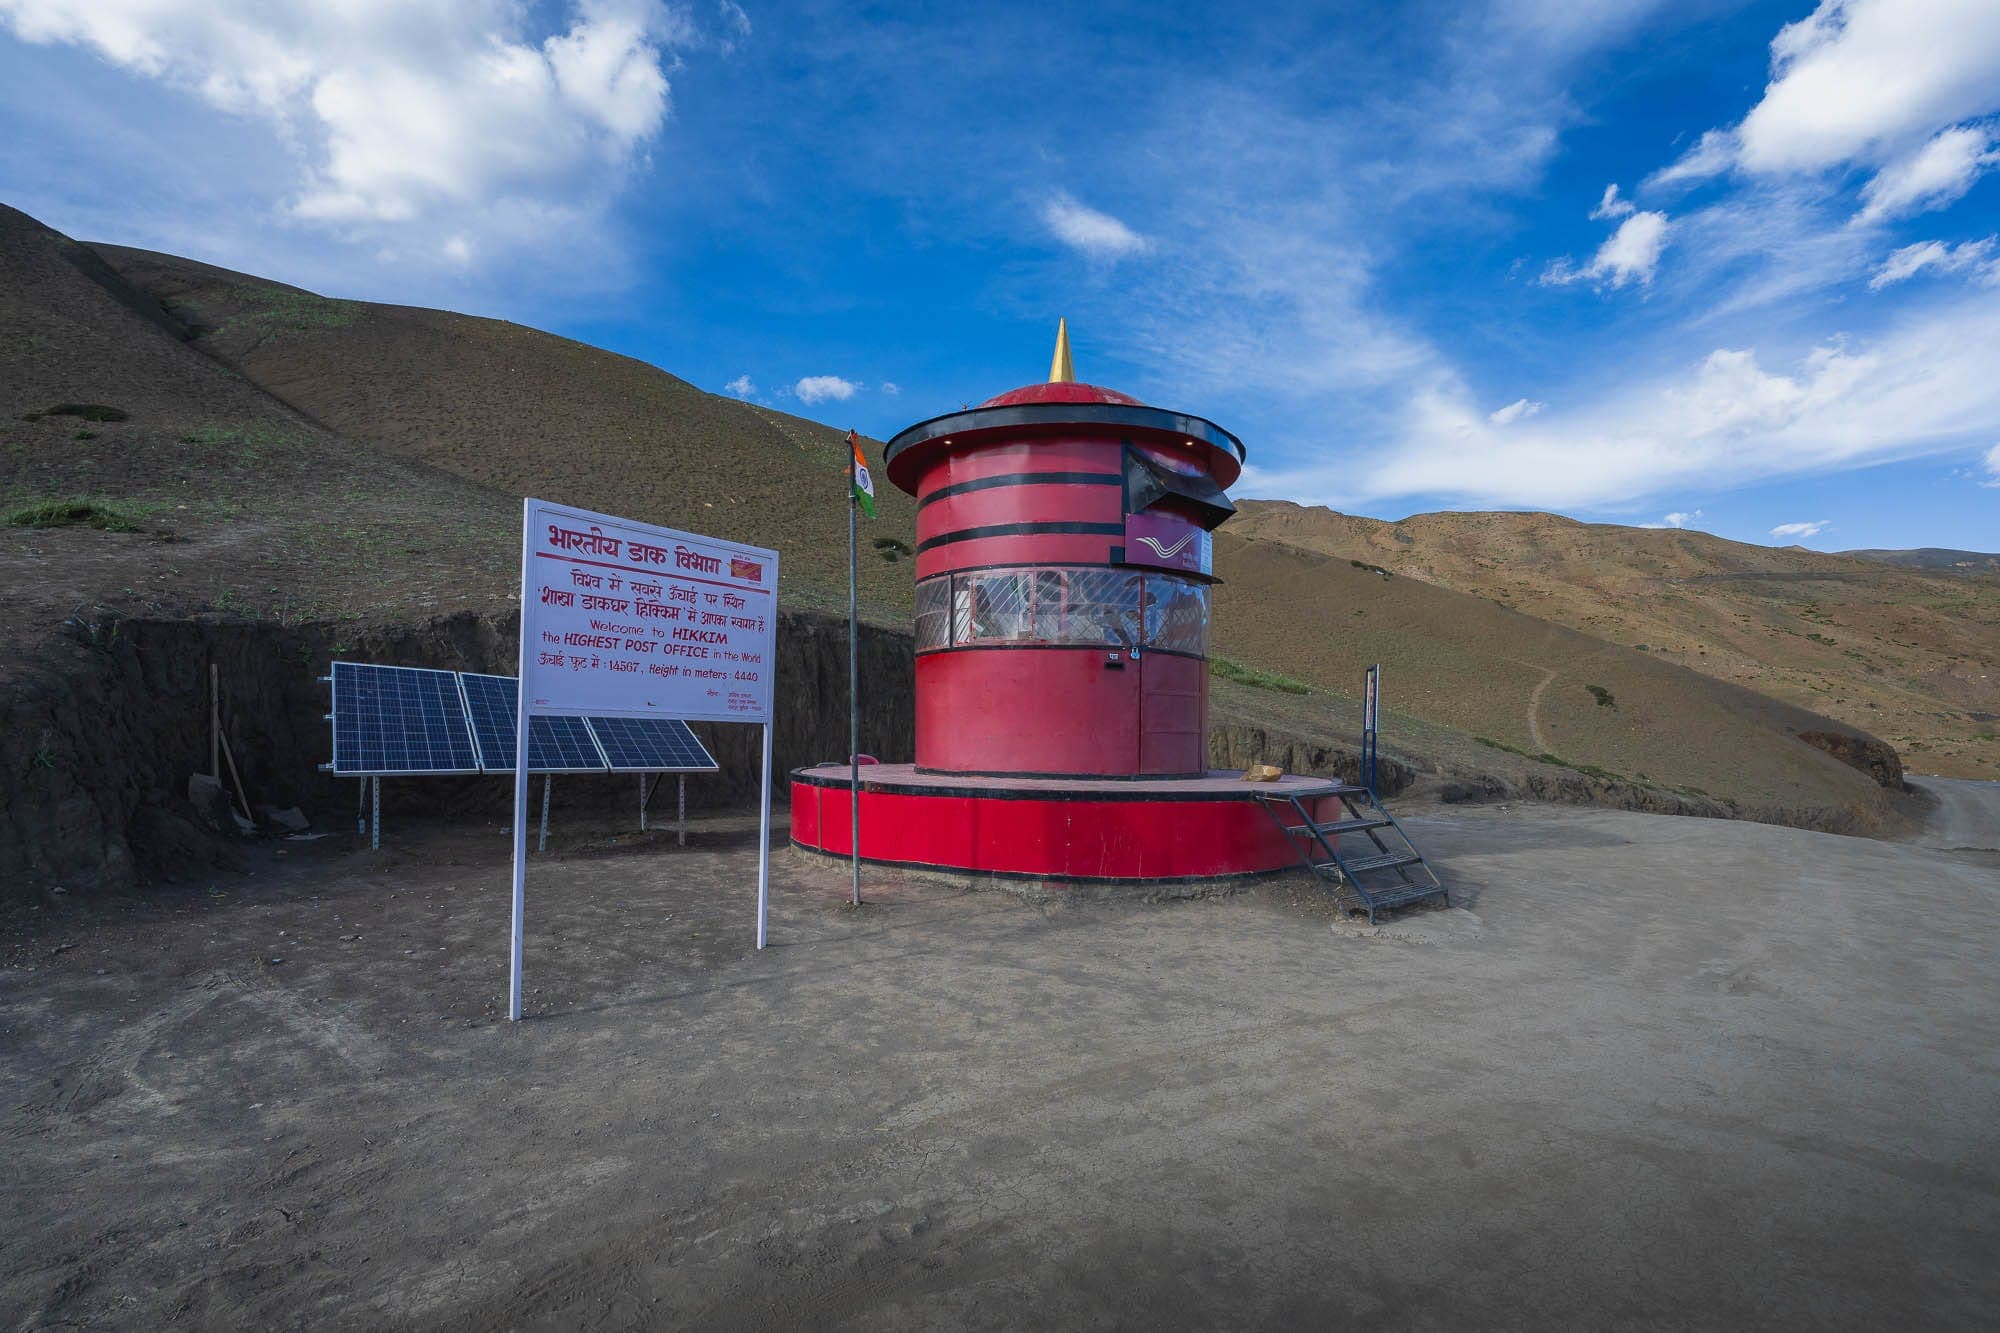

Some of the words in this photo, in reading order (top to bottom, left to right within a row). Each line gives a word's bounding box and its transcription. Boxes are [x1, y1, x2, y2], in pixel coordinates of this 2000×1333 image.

[549, 525, 623, 558] भारतीय
[627, 541, 668, 565] डाक
[674, 545, 722, 575] विभाग
[607, 573, 623, 592] में
[703, 593, 718, 608] पर
[581, 594, 630, 616] डाकघर
[688, 607, 698, 623] में
[701, 611, 728, 627] आपका
[731, 616, 757, 631] स्वागत
[541, 631, 560, 645] the
[564, 632, 621, 650] HIGHEST
[625, 639, 659, 653] POST
[663, 643, 709, 659] OFFICE
[713, 651, 721, 659] in
[724, 652, 739, 662] the
[741, 652, 761, 664] World
[590, 619, 644, 636] Welcome
[653, 627, 665, 638] to
[672, 627, 728, 645] HIKKIM
[591, 653, 600, 669] में
[649, 664, 679, 678] Height
[682, 666, 691, 677] in
[695, 669, 727, 680] meters
[734, 670, 758, 682] 4440
